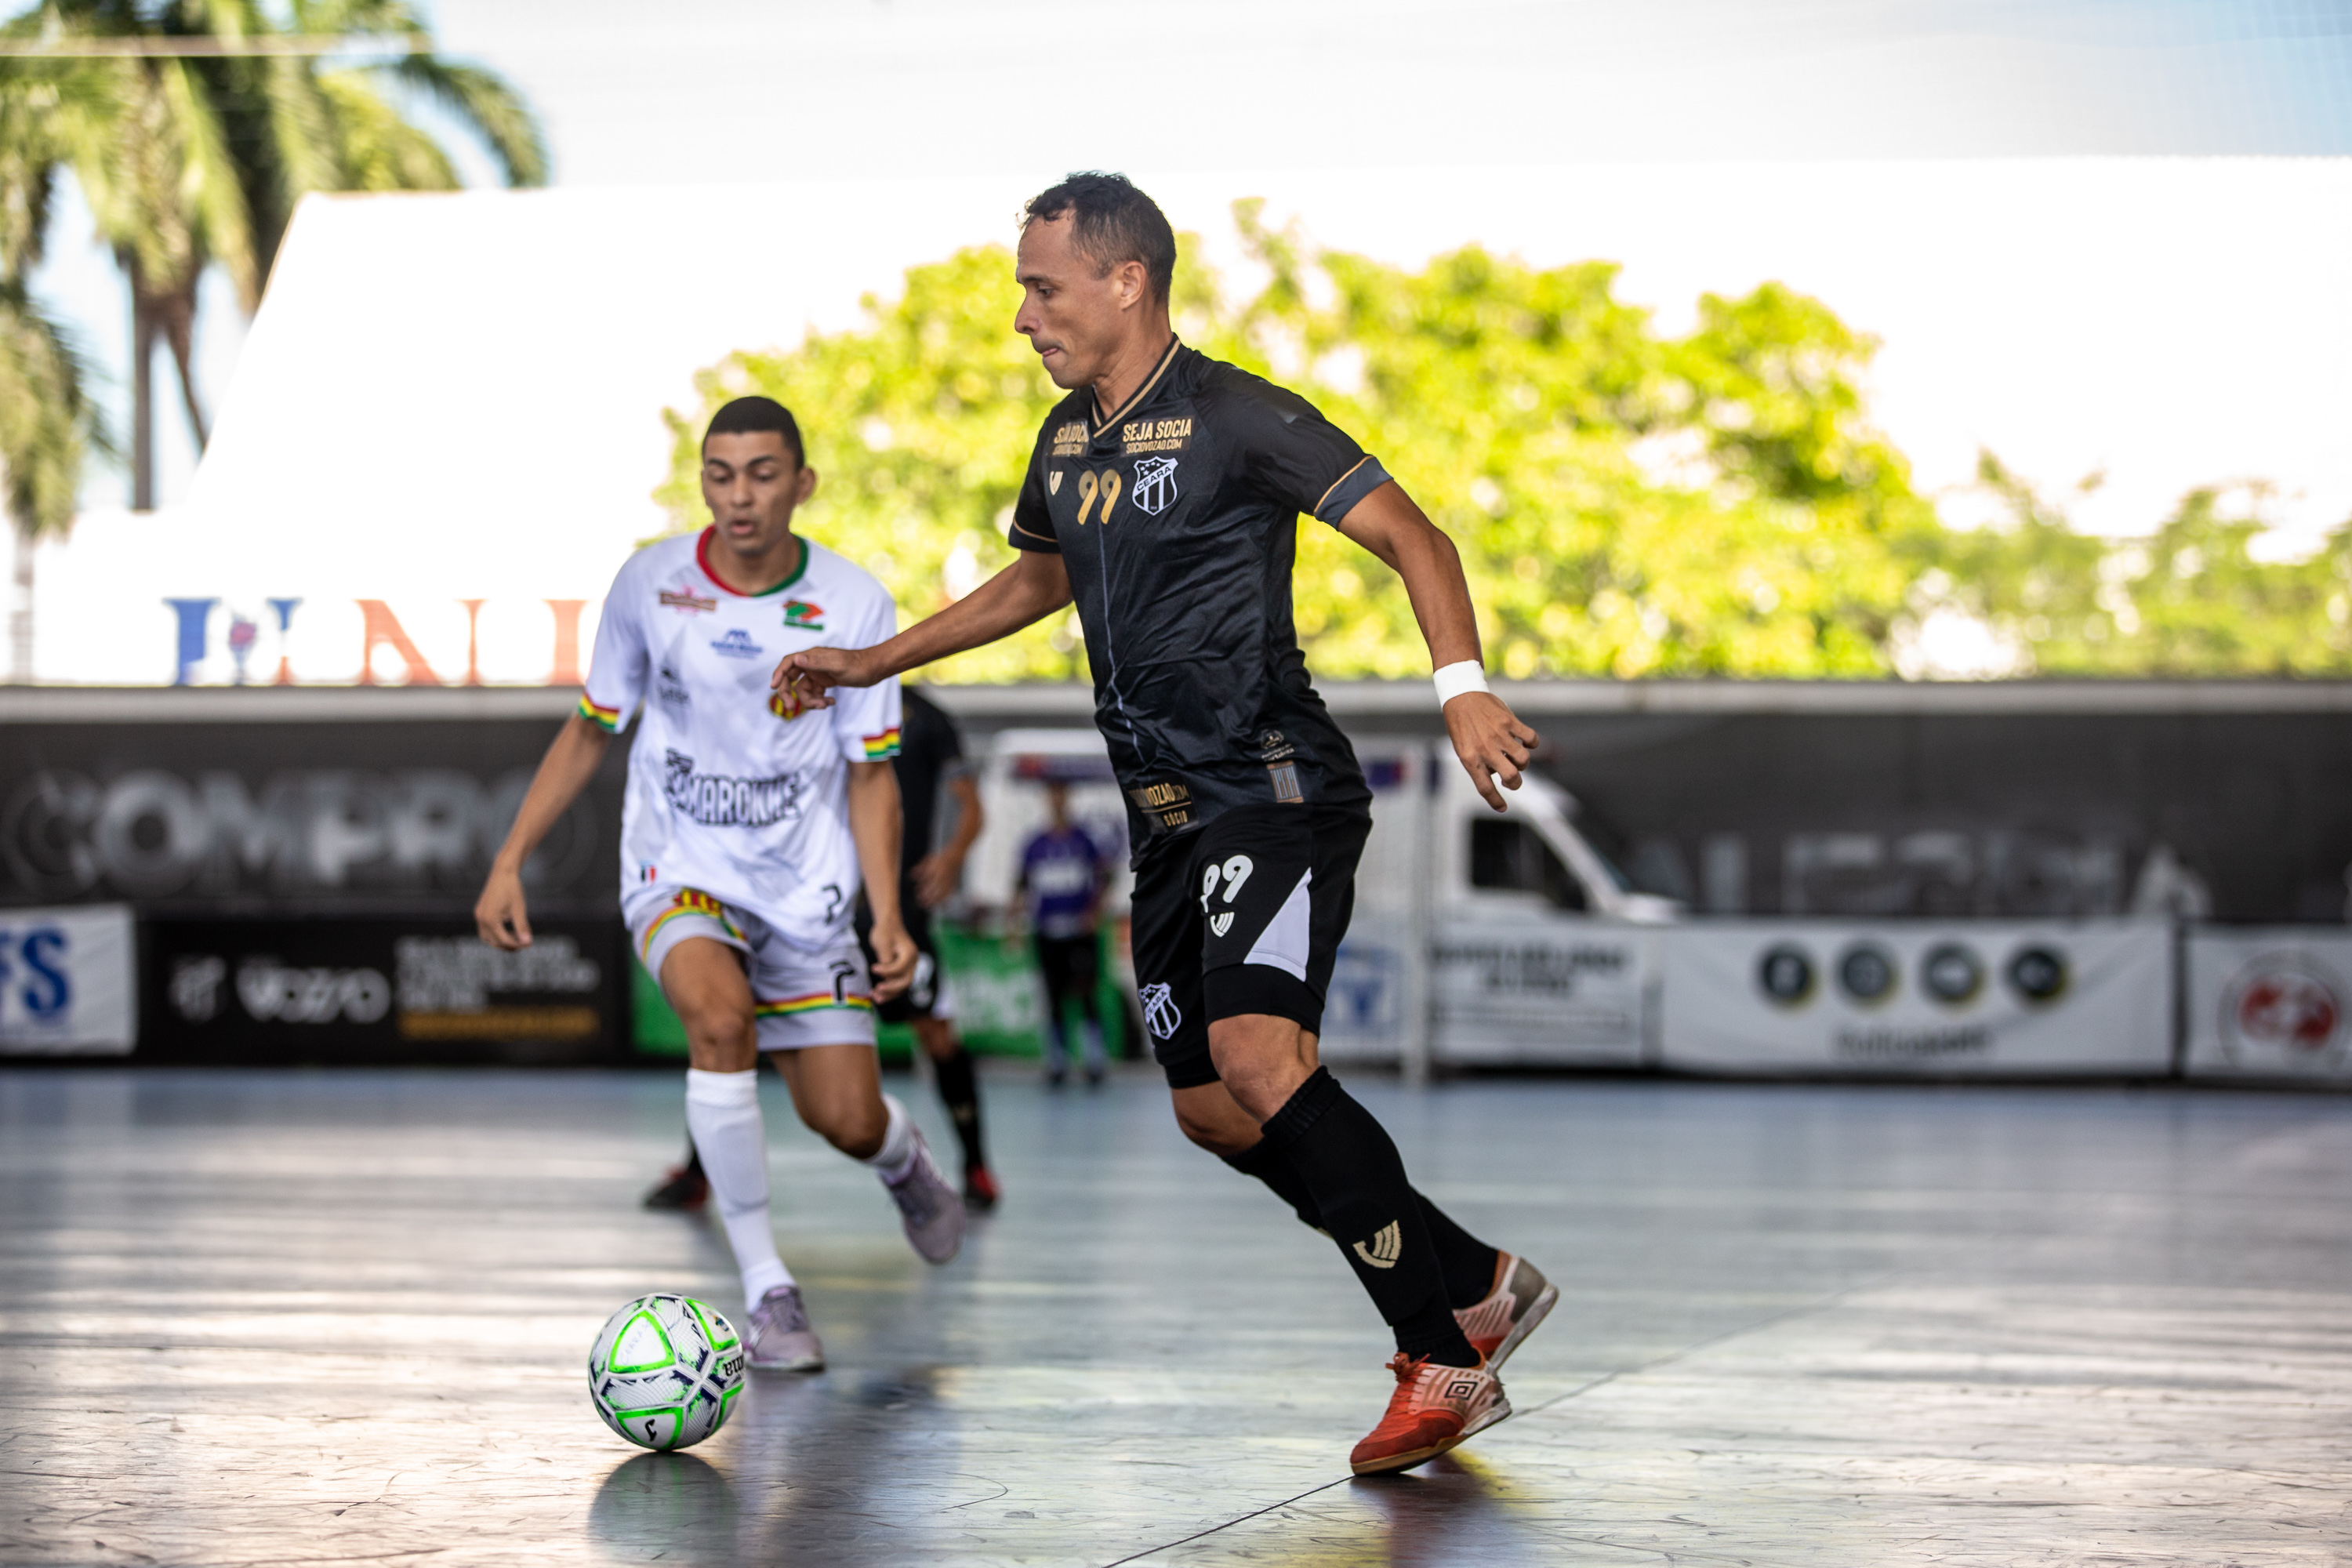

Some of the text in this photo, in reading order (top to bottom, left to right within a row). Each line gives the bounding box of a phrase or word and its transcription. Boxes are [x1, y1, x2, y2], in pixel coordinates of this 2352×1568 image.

[1123, 418, 1192, 442] SEJA SOCIA
[1077, 469, 1122, 525] 99
[1200, 855, 1254, 913] 99
